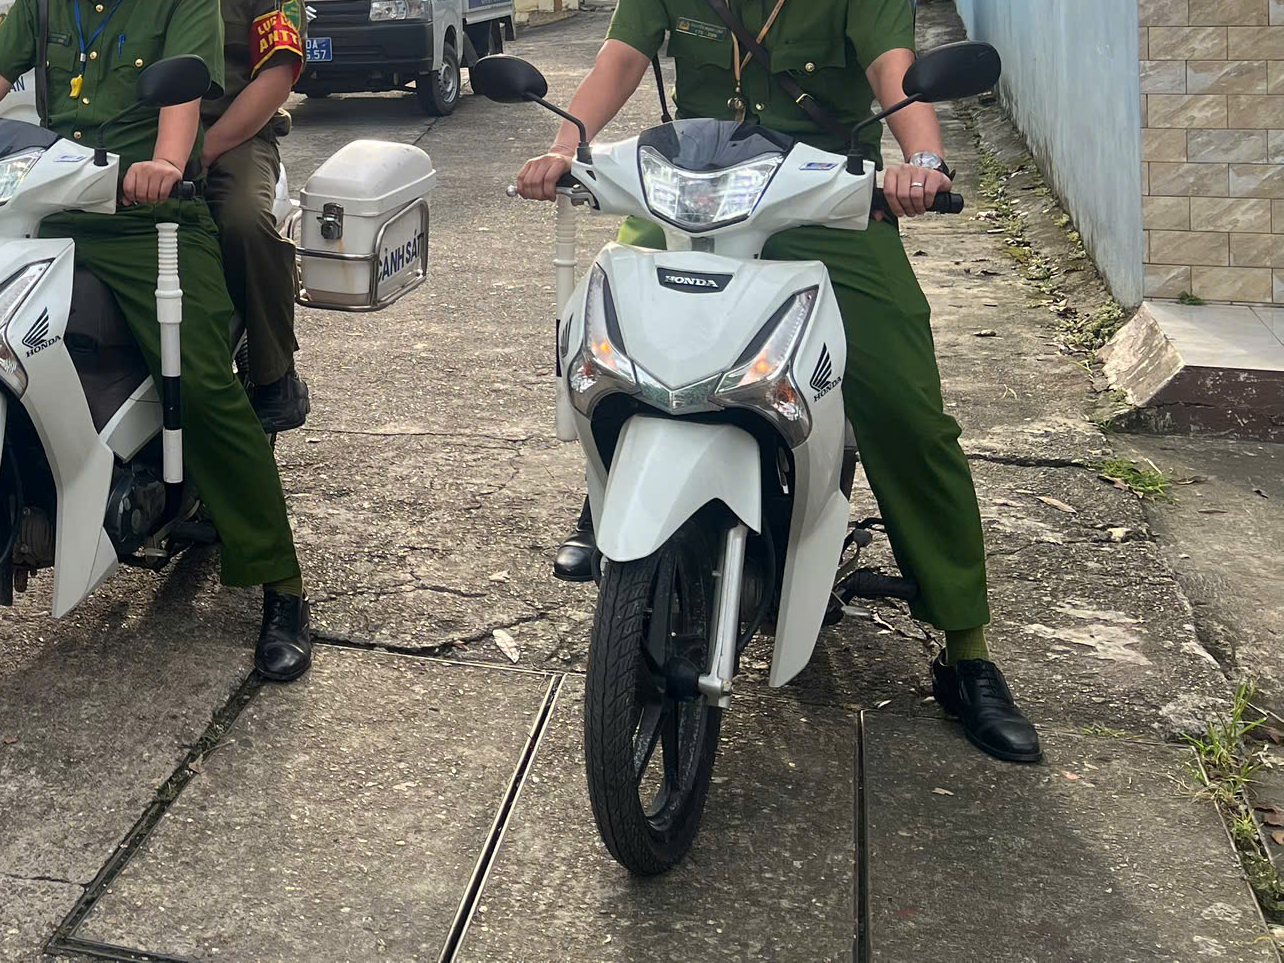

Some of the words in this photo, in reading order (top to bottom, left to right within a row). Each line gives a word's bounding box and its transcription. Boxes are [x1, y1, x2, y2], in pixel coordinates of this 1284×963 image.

[306, 40, 318, 49] 0A
[664, 275, 719, 288] HONDA
[26, 335, 62, 358] HONDA
[813, 376, 842, 403] HONDA
